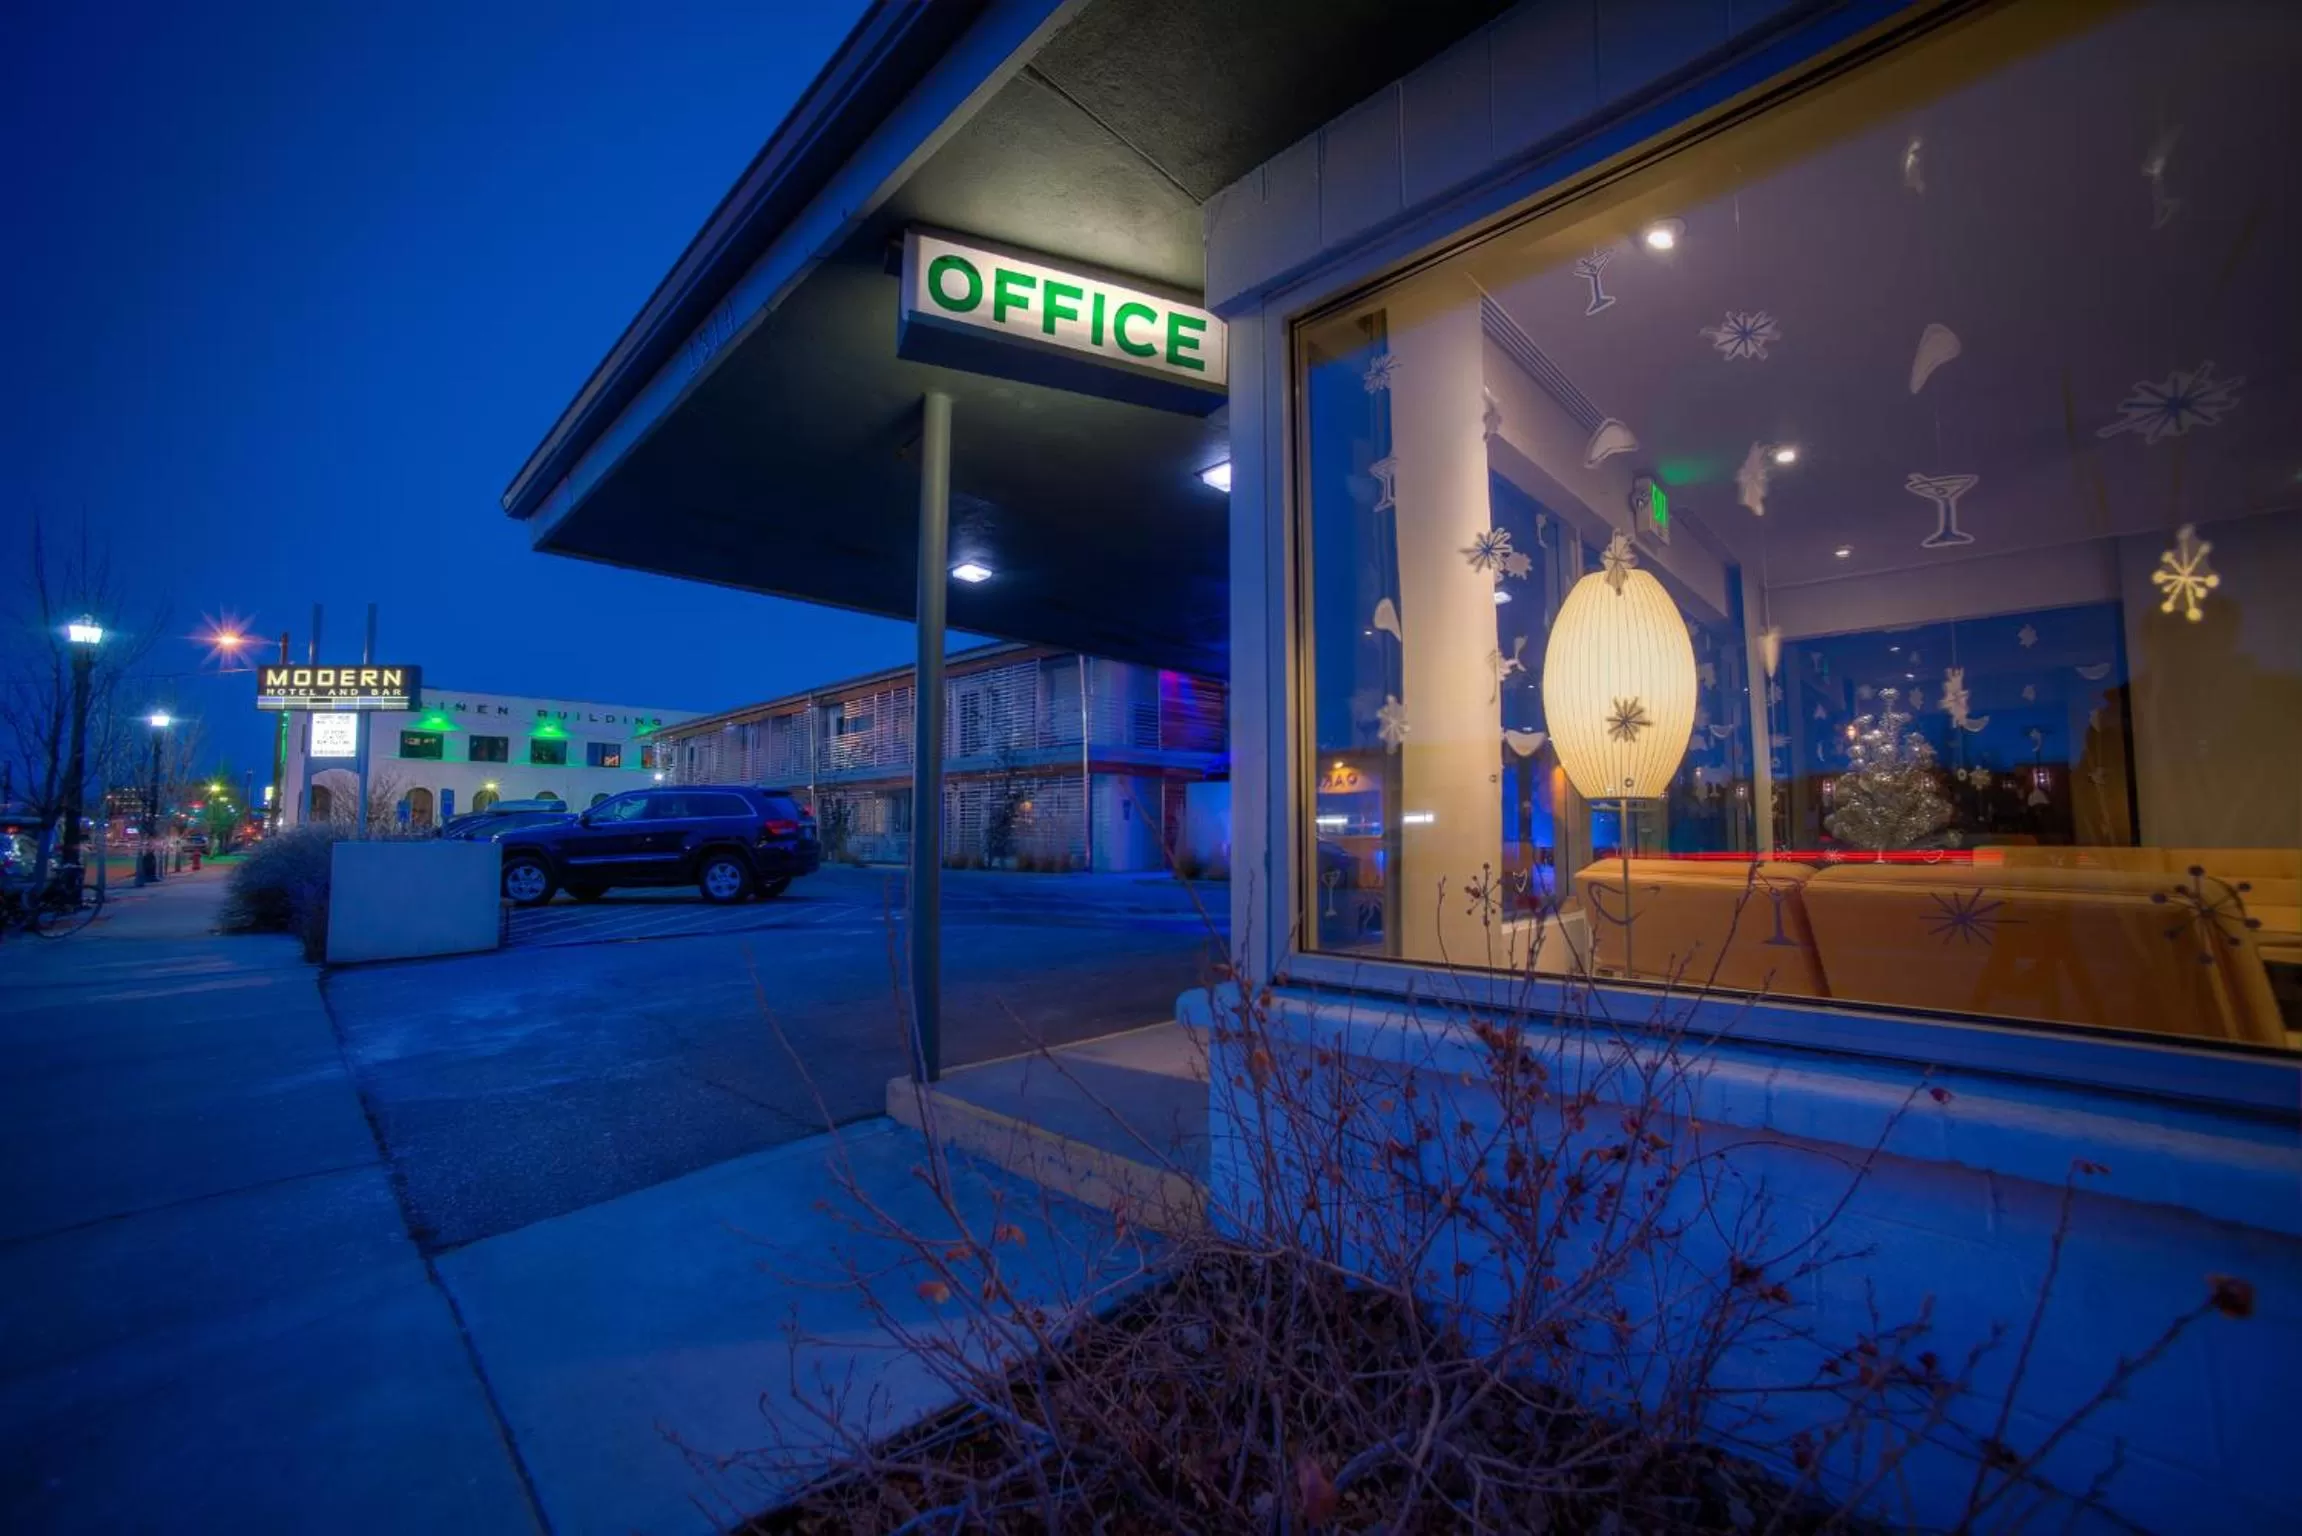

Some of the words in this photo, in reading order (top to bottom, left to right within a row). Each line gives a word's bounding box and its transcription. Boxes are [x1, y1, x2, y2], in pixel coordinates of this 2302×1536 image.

[927, 254, 1207, 372] OFFICE
[266, 668, 402, 686] MODERN
[266, 688, 316, 696] HOTEL
[328, 688, 359, 696] AND
[371, 688, 402, 696] BAR
[536, 708, 663, 726] BUILDING
